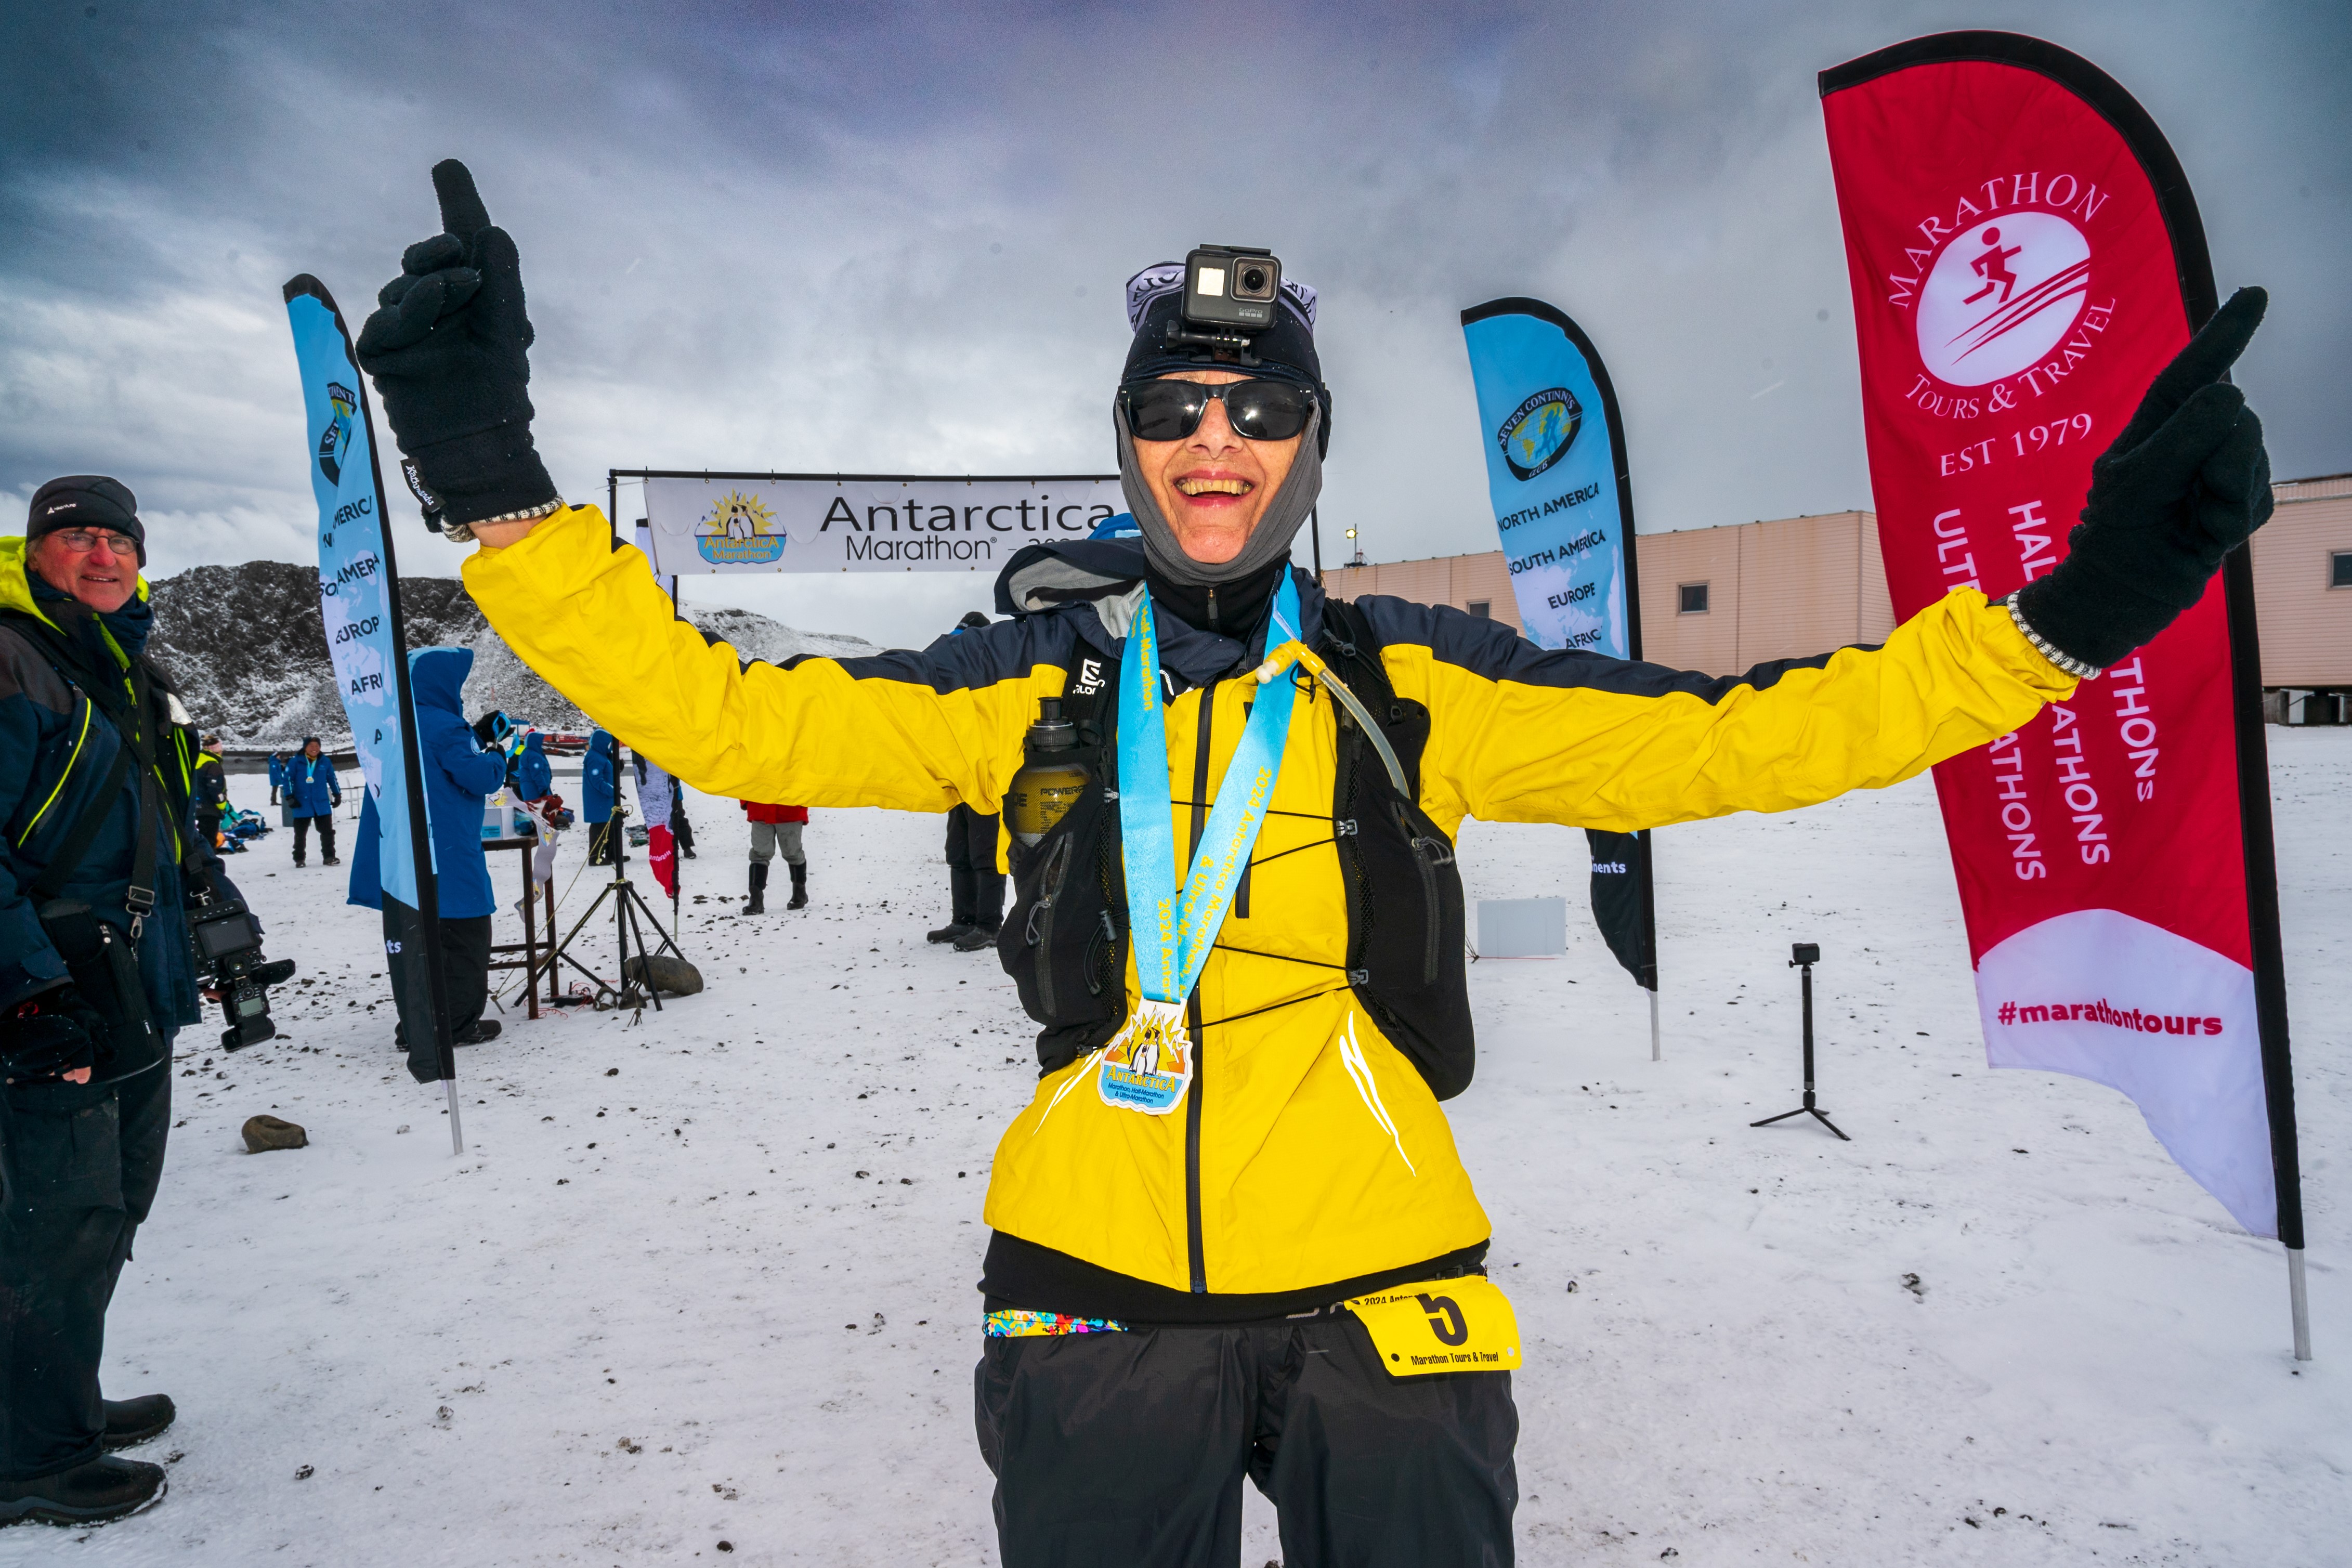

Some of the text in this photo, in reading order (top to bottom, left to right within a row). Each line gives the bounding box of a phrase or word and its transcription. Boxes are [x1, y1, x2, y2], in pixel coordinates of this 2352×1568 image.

[1888, 172, 2111, 310] MARATHON
[1905, 297, 2116, 419] TOURS & TRAVEL
[1499, 408, 1525, 446] SEVEN
[1940, 413, 2092, 477] EST 1979
[406, 465, 434, 506] Kathmandu
[819, 495, 1114, 532] Antarctica
[1498, 482, 1600, 531] NORTH AMERICA
[713, 550, 771, 559] Marathon
[1509, 529, 1606, 576] SOUTH AMERICA
[1548, 582, 1596, 609] EUROPE
[336, 615, 380, 644] EUROP
[1565, 625, 1603, 650] AFRIC
[2110, 657, 2159, 802] THONS
[1247, 765, 1272, 808] 2024
[2052, 704, 2110, 865] ATHONS
[1199, 855, 1214, 869] &
[1215, 809, 1255, 891] Antarctica
[1158, 898, 1172, 943] 2024
[1997, 998, 2223, 1036] #marathontours
[1119, 1092, 1153, 1104] Ultra-Marathon
[1131, 1087, 1165, 1100] Half-Marathon
[1415, 1293, 1468, 1347] 5
[1410, 1352, 1499, 1366] Marathon Tours & Travel
